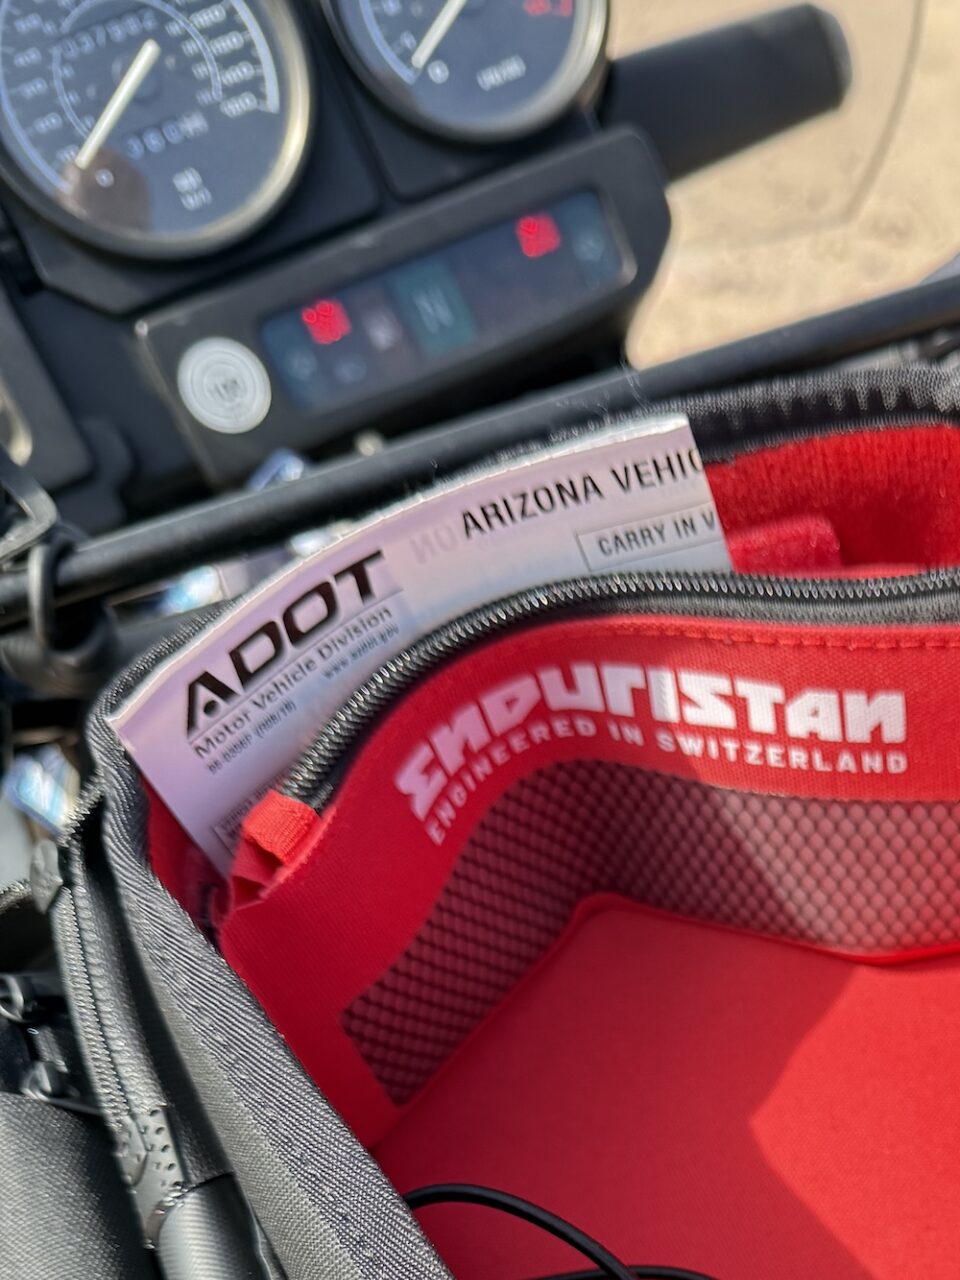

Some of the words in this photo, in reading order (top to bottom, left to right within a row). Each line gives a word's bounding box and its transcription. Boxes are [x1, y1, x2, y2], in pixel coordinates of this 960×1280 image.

[460, 471, 605, 539] ARIZONA
[598, 523, 667, 557] CARRY
[674, 516, 698, 539] IN
[186, 549, 384, 740] ADOT
[193, 709, 252, 759] Motor
[252, 659, 318, 711] Vehicle
[317, 605, 394, 662] Division
[394, 661, 907, 822] ENDURISTAN
[424, 714, 598, 846] ENGINEERED
[606, 718, 645, 747] IN
[654, 728, 909, 775] SWITZERLAND
